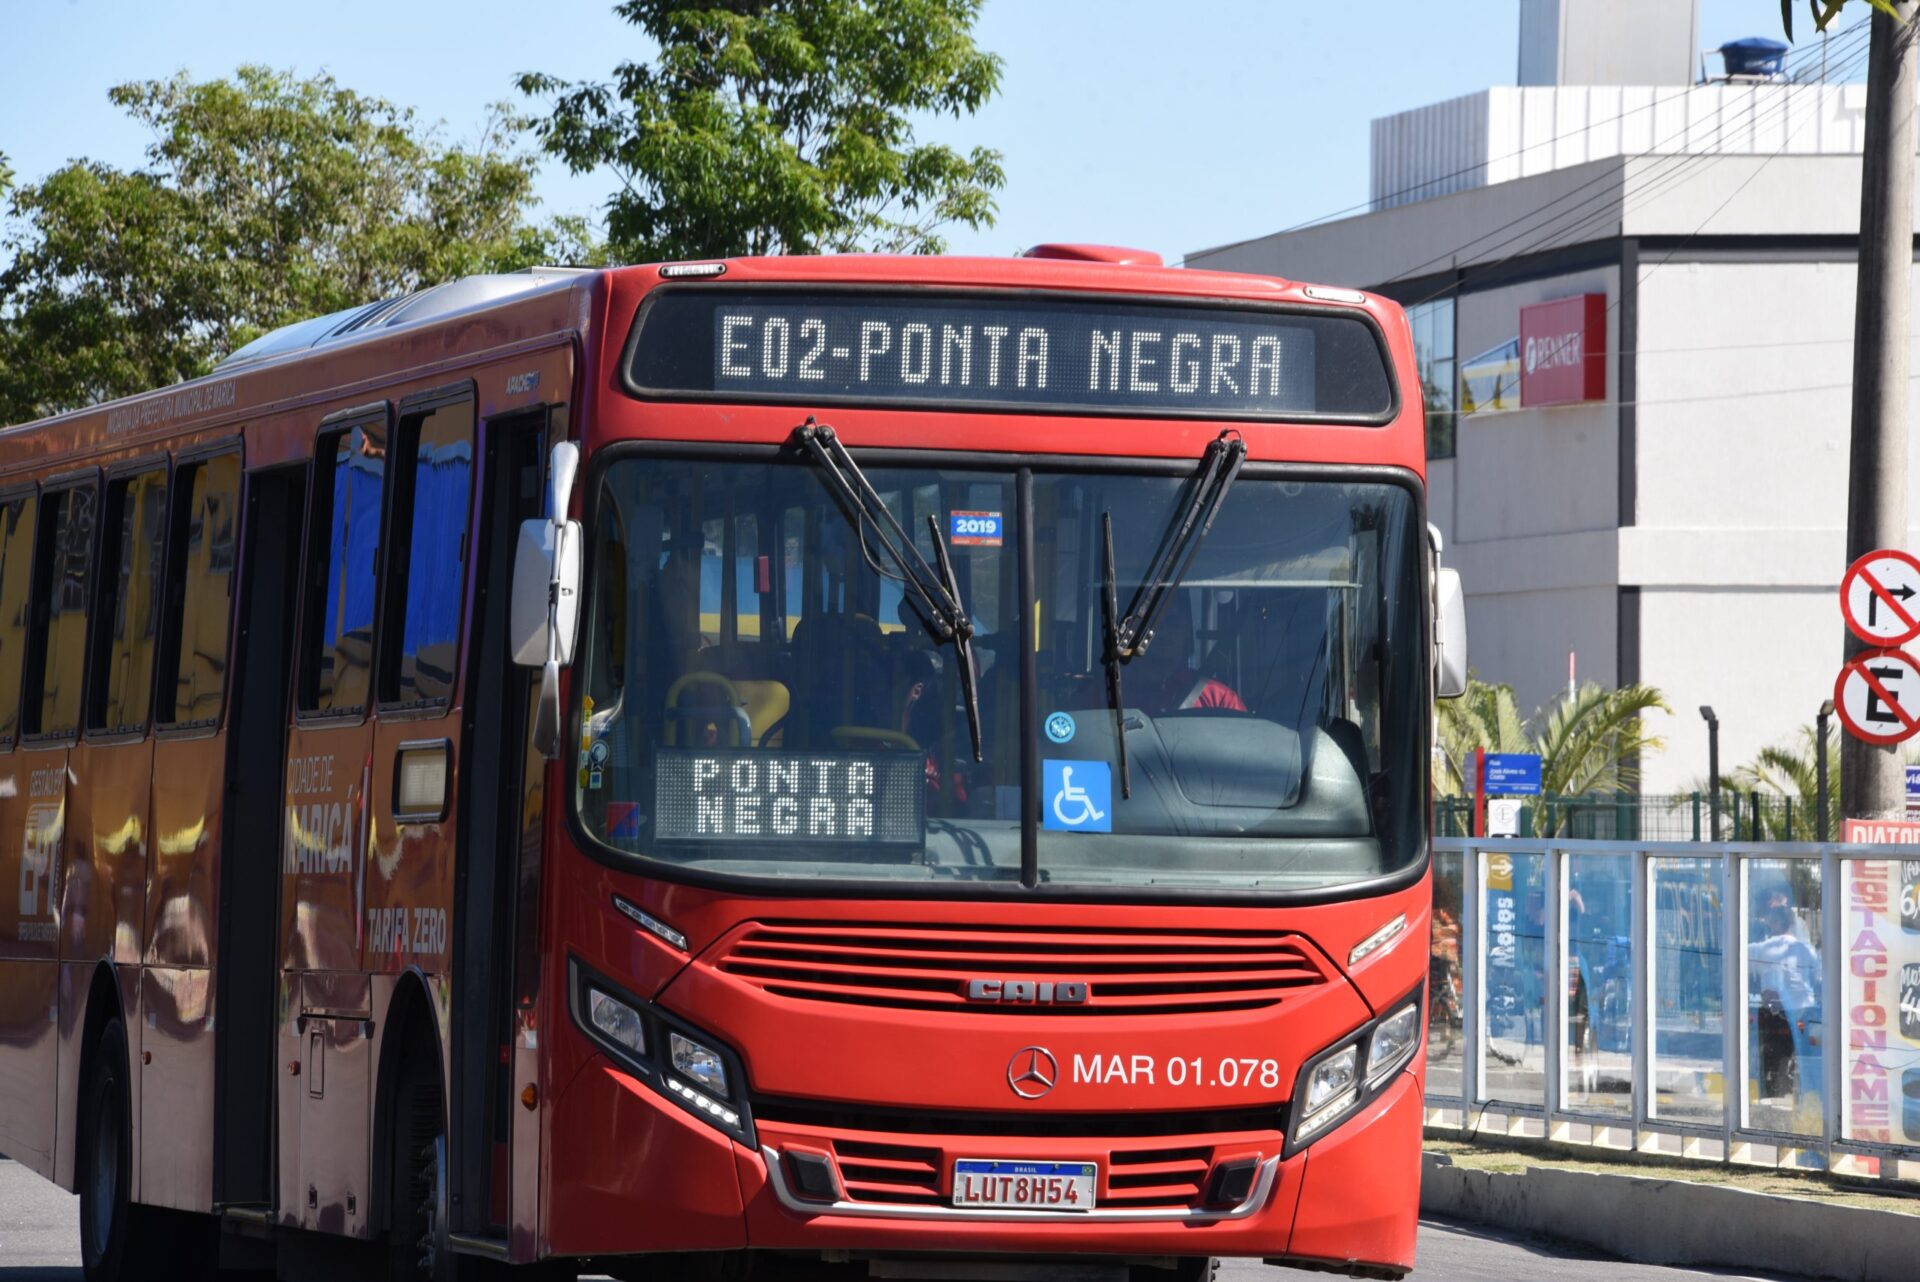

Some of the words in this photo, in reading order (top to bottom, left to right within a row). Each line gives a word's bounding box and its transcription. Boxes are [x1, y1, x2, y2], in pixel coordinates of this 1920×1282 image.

[1090, 330, 1281, 396] NEGRA
[1537, 333, 1581, 369] RENNER
[956, 519, 997, 534] 2019
[288, 757, 319, 795] CIDADE
[319, 756, 334, 792] DE
[694, 759, 873, 795] PONTA
[697, 796, 873, 836] NEGRA
[368, 908, 410, 953] TARIFA
[412, 908, 447, 955] ZERO
[968, 979, 1089, 1003] CAIO
[1073, 1054, 1155, 1085] MAR
[1166, 1056, 1280, 1088] 01.078
[1014, 1166, 1038, 1174] BRASIL
[964, 1176, 1078, 1205] LUT8H54
